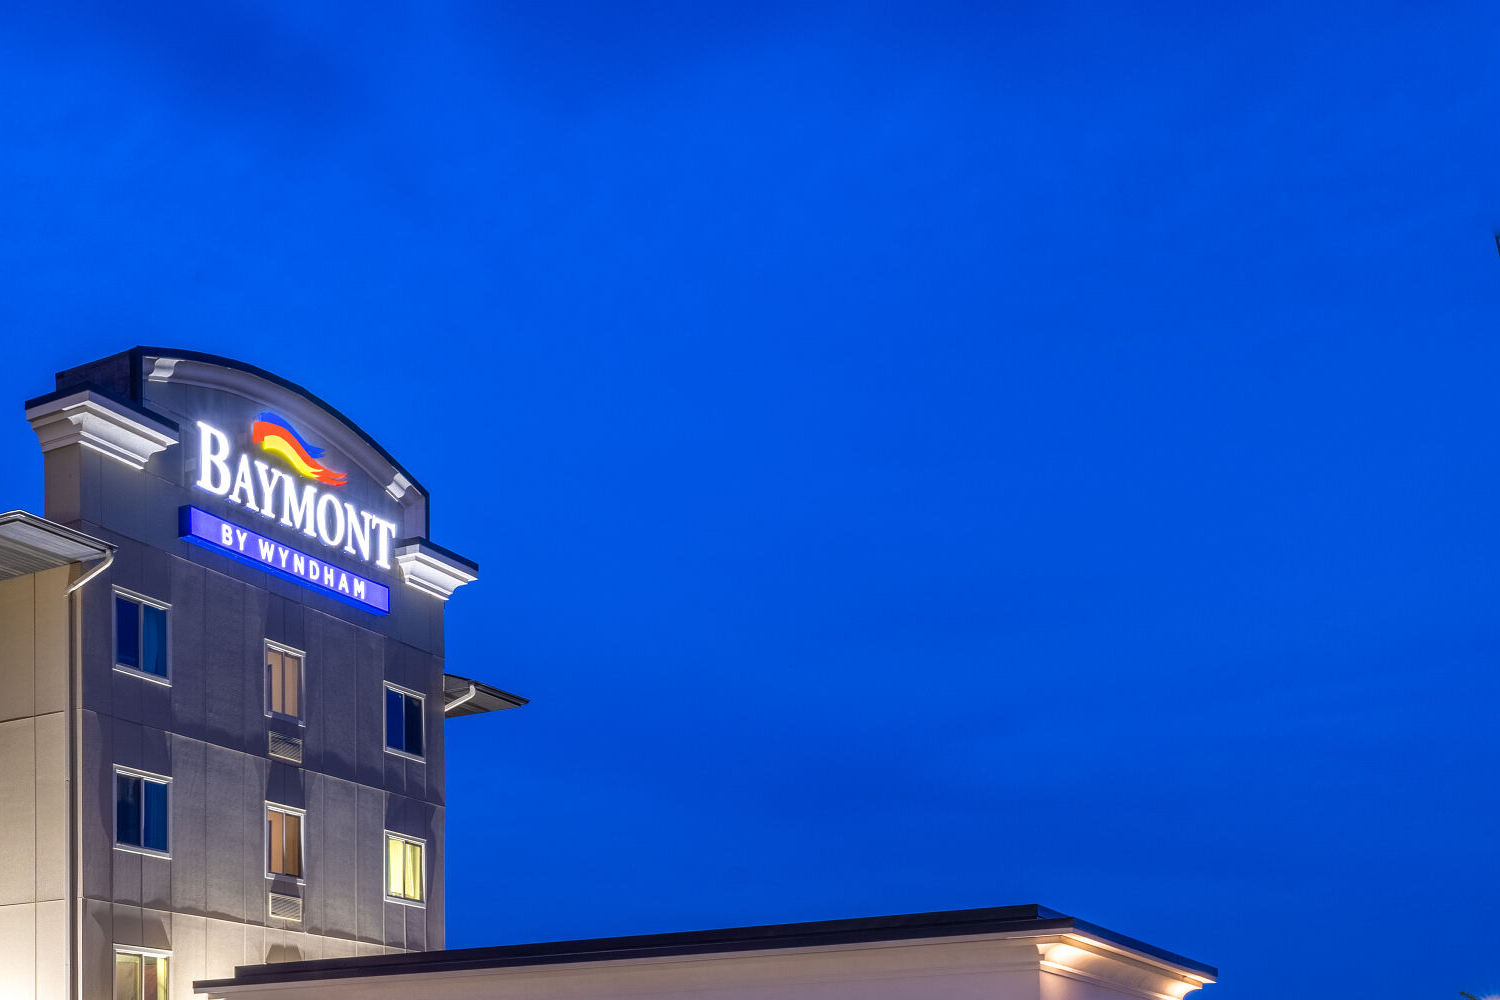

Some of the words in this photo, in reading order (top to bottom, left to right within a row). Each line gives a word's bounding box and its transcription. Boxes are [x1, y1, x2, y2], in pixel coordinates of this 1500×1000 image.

[196, 420, 396, 570] BAYMONT
[221, 523, 248, 551] BY
[258, 538, 366, 600] WYNDHAM
